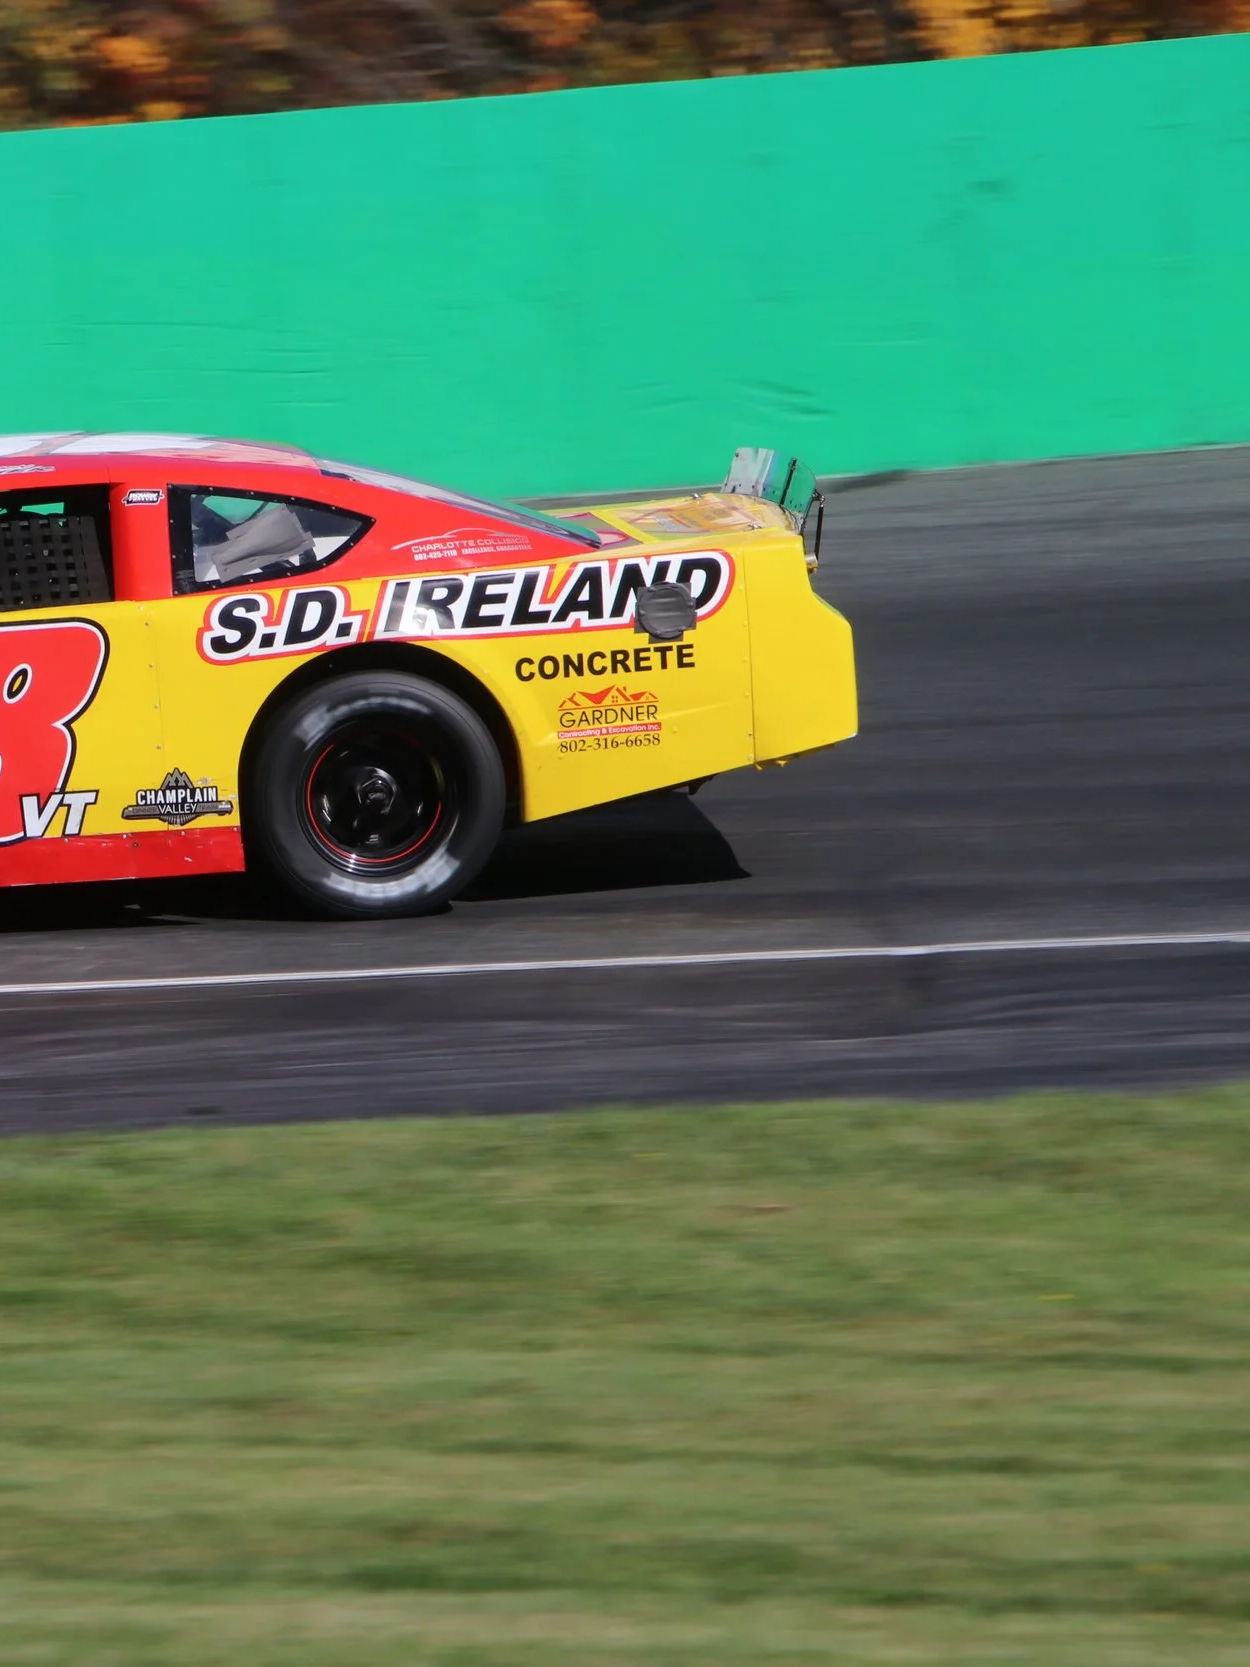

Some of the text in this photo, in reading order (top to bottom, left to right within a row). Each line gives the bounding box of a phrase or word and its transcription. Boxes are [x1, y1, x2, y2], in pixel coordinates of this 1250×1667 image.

[411, 539, 475, 553] CHARLOTTE
[208, 556, 722, 655] S.D. IRELAND
[515, 643, 696, 682] CONCRETE
[559, 704, 658, 728] GARDNER
[558, 729, 600, 738] Contracting
[609, 724, 646, 734] Excavation
[559, 733, 661, 753] 802-316-6658
[137, 786, 217, 805] CHAMPLAIN
[19, 790, 99, 838] VT
[158, 803, 197, 814] VALLEY
